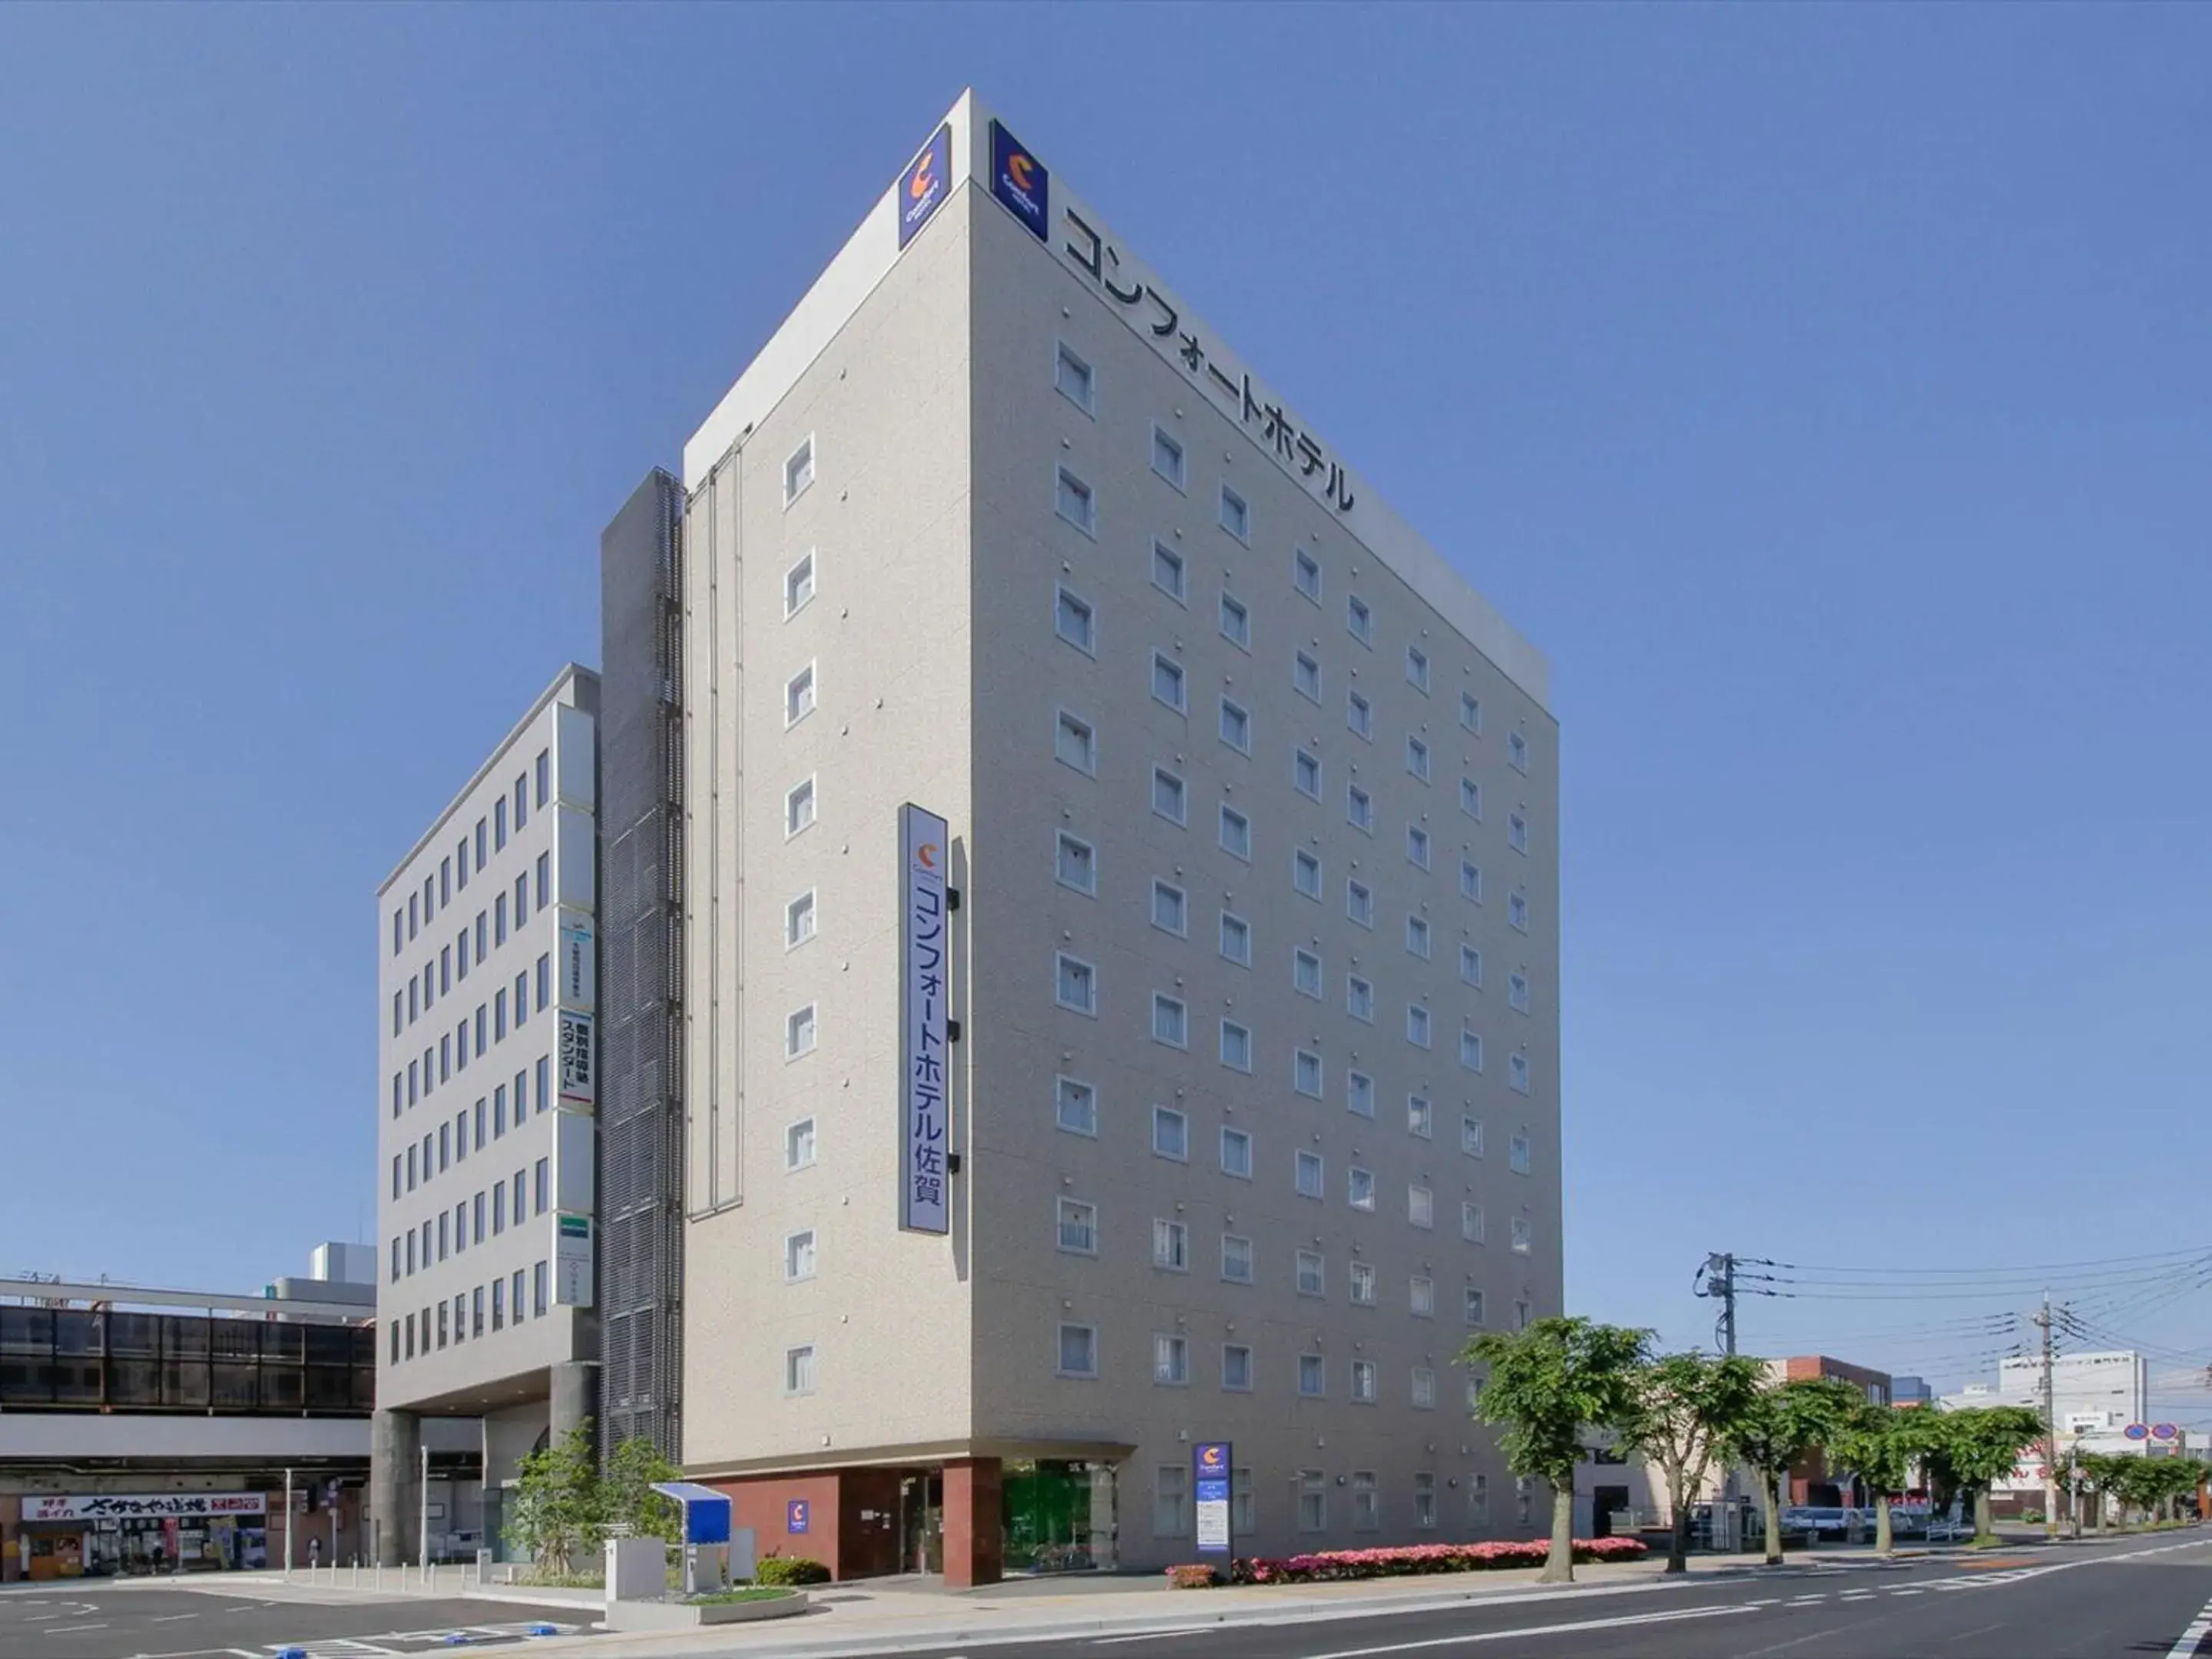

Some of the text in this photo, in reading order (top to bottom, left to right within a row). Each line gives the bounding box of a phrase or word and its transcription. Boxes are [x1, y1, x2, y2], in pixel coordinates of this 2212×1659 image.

[1065, 206, 1354, 512] コンフォートホテル
[914, 886, 943, 1207] コンフォートホテル佐賀
